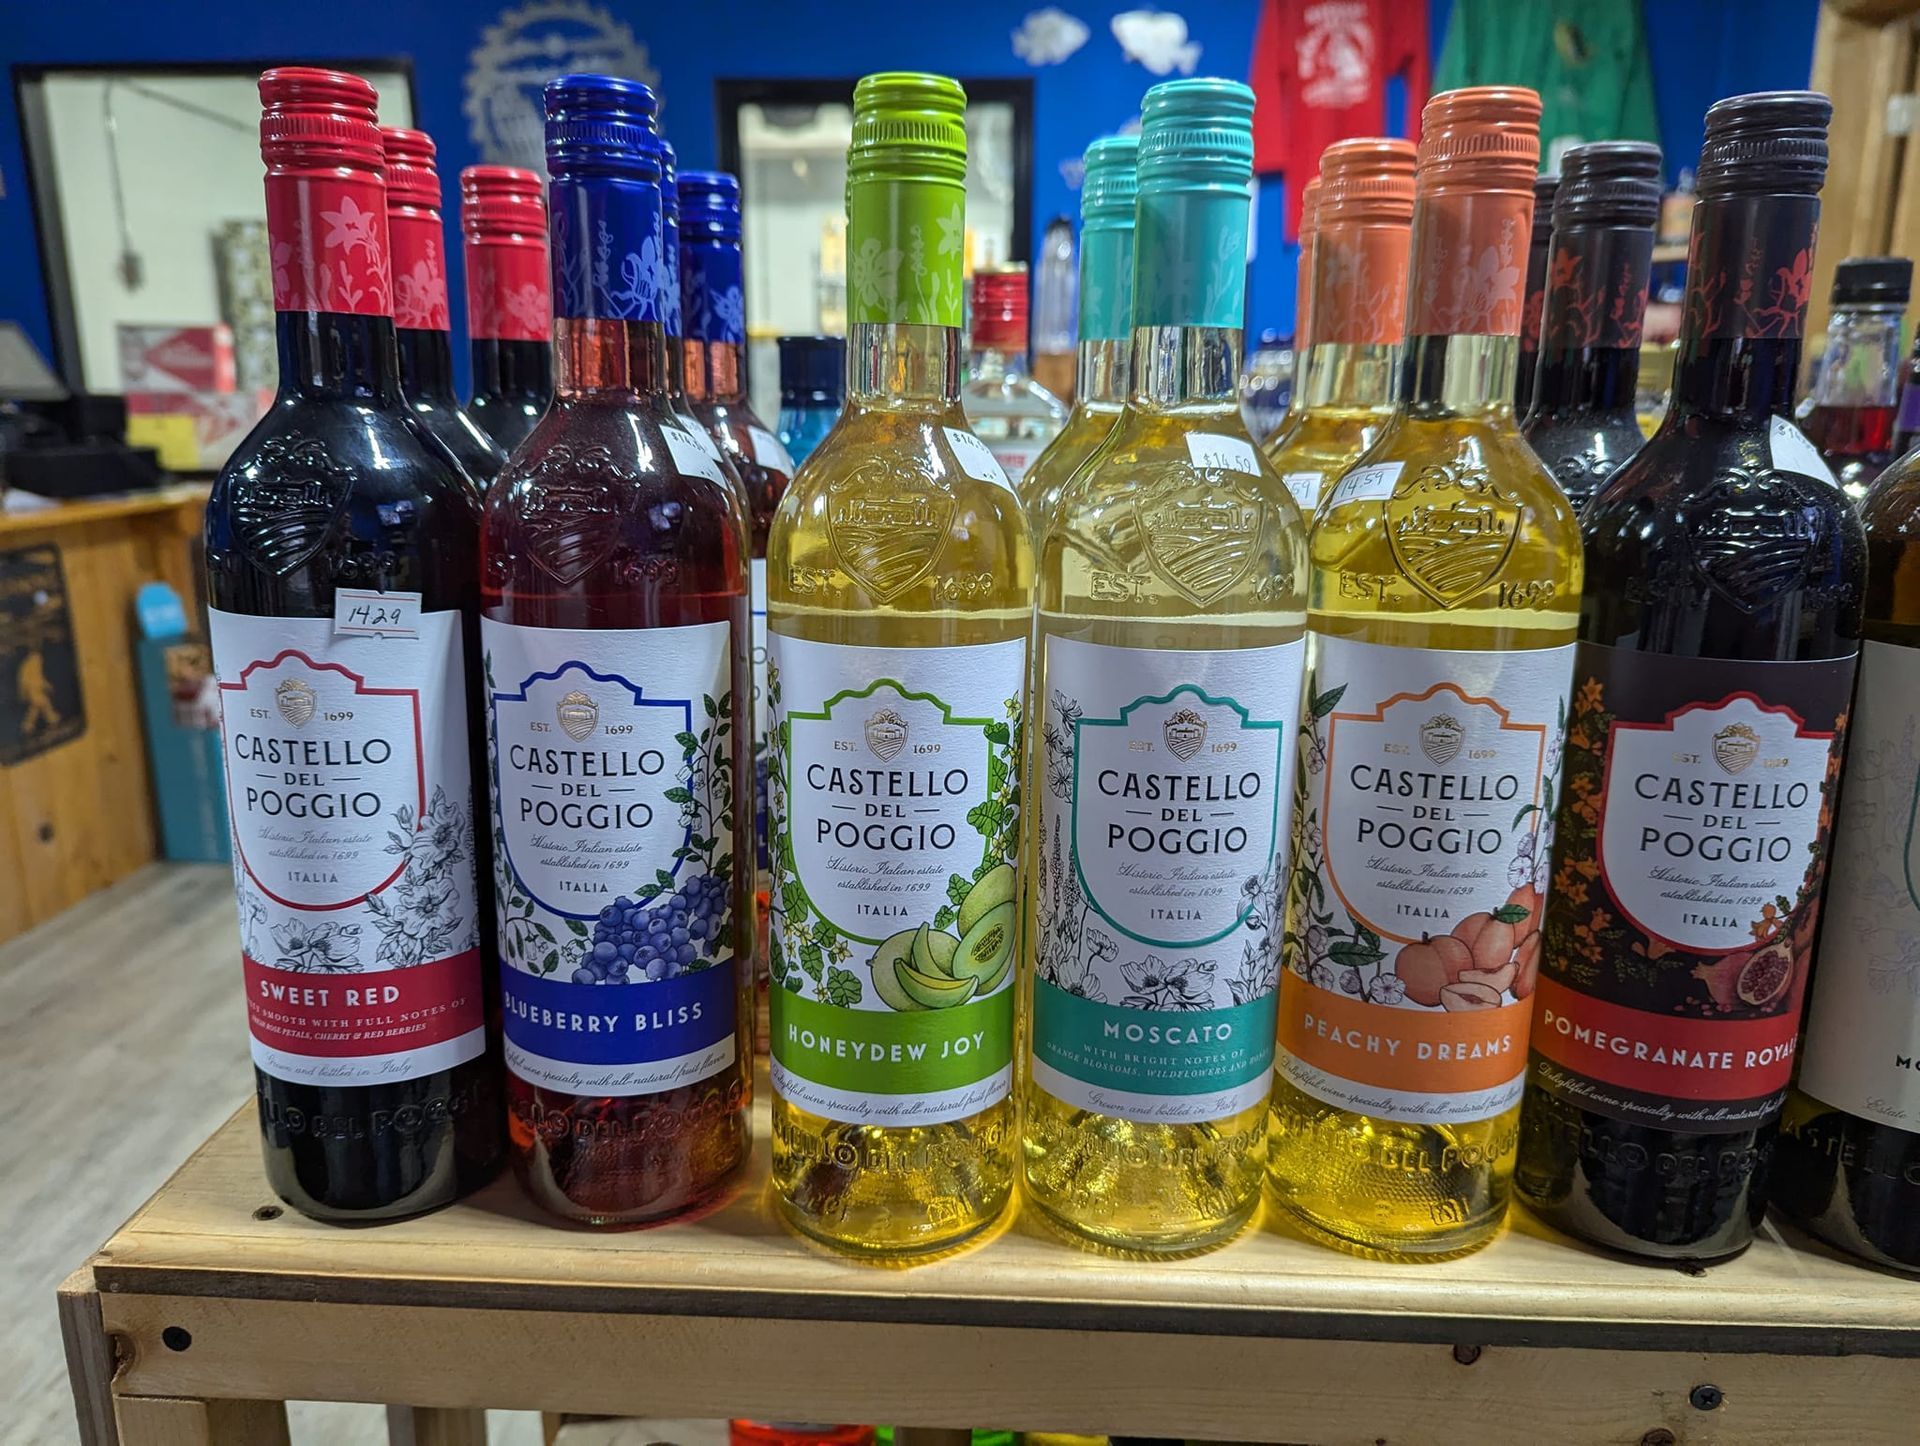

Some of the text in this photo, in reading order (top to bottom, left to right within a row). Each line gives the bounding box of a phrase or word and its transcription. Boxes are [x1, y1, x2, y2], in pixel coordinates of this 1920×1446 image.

[1341, 472, 1384, 498] 14.59
[1340, 570, 1400, 603] EST.
[250, 708, 354, 722] EST. 1699
[530, 722, 633, 735] EST. 1699
[235, 733, 392, 766] CASTELLO
[834, 740, 941, 754] EST. 1699
[1211, 743, 1237, 753] 1699
[510, 744, 664, 777] CASTELLO
[284, 772, 325, 786] DEL
[807, 764, 968, 798] CASTELLO
[1098, 769, 1261, 802] CASTELLO
[1350, 764, 1518, 802] CASTELLO
[561, 783, 601, 797] DEL
[1634, 772, 1808, 809] CASTELLO
[247, 788, 381, 818] POGGIO
[864, 804, 906, 818] DEL
[1412, 805, 1455, 822] DEL
[520, 798, 654, 830] POGGIO
[1161, 808, 1202, 822] DEL
[1702, 814, 1748, 830] DEL
[257, 826, 298, 843] Historic
[293, 831, 341, 845] Italian
[530, 834, 570, 852] Historic
[568, 840, 613, 854] Italian
[817, 818, 956, 851] POGGIO
[1108, 824, 1248, 854] POGGIO
[1357, 818, 1502, 854] POGGIO
[1639, 827, 1791, 862] POGGIO
[268, 849, 317, 860] established
[331, 851, 360, 860] 1699
[540, 856, 588, 870] established
[603, 860, 630, 870] 1699
[826, 856, 869, 875] Historic
[868, 862, 916, 877] Italian
[1116, 861, 1162, 880] Historic
[1162, 866, 1210, 882] Italian
[1365, 854, 1412, 876] Historic
[1412, 862, 1460, 880] Italian
[288, 872, 338, 883] ITALIA
[560, 881, 608, 893] ITALIA
[836, 878, 890, 892] established
[904, 882, 930, 892] 1699
[1376, 878, 1432, 894] established
[1448, 886, 1474, 896] 1699
[1648, 865, 1700, 886] Historic
[1700, 874, 1748, 890] Italian
[1129, 884, 1182, 898] established
[1198, 887, 1222, 897] 1699
[1660, 889, 1720, 904] established
[1736, 896, 1762, 906] 1699
[856, 904, 908, 916] ITALIA
[1150, 908, 1202, 920] ITALIA
[1396, 904, 1450, 918] ITALIA
[1682, 912, 1738, 928] ITALIA
[260, 980, 400, 1006] SWEET RED
[263, 1009, 306, 1026] SMOOTH
[312, 1019, 349, 1028] WITH
[356, 1016, 394, 1027] FULL
[400, 1004, 447, 1022] NOTES
[504, 991, 703, 1033] BLUEBERRY BLISS
[363, 1030, 384, 1040] RED
[385, 1022, 427, 1037] BERRIES
[1104, 1020, 1232, 1044] MOSCATO
[1304, 1014, 1400, 1057] PEACHY
[1416, 1034, 1512, 1060] DREAMS
[1544, 1008, 1732, 1070] POMEGRANATE
[788, 1024, 985, 1062] HONEYDEW JOY
[1084, 1043, 1117, 1059] WITH
[1124, 1053, 1177, 1065] BRIGHT
[1184, 1053, 1226, 1064] NOTES
[1231, 1048, 1246, 1058] OF
[1083, 1056, 1140, 1076] BLOSSOMS,
[1147, 1064, 1226, 1078] WILDFLOWERS
[544, 1071, 584, 1088] specialty
[585, 1072, 614, 1086] with
[1538, 1061, 1596, 1096] Delightful
[1620, 1104, 1676, 1122] specialty
[1676, 1108, 1709, 1120] with
[803, 1094, 826, 1104] wine
[826, 1100, 872, 1118] specialty
[874, 1102, 902, 1116] with
[902, 1092, 968, 1115] all-natural
[1128, 1106, 1154, 1115] and
[1154, 1103, 1192, 1116] bottled
[1346, 1098, 1397, 1114] specialty
[1400, 1101, 1429, 1114] with
